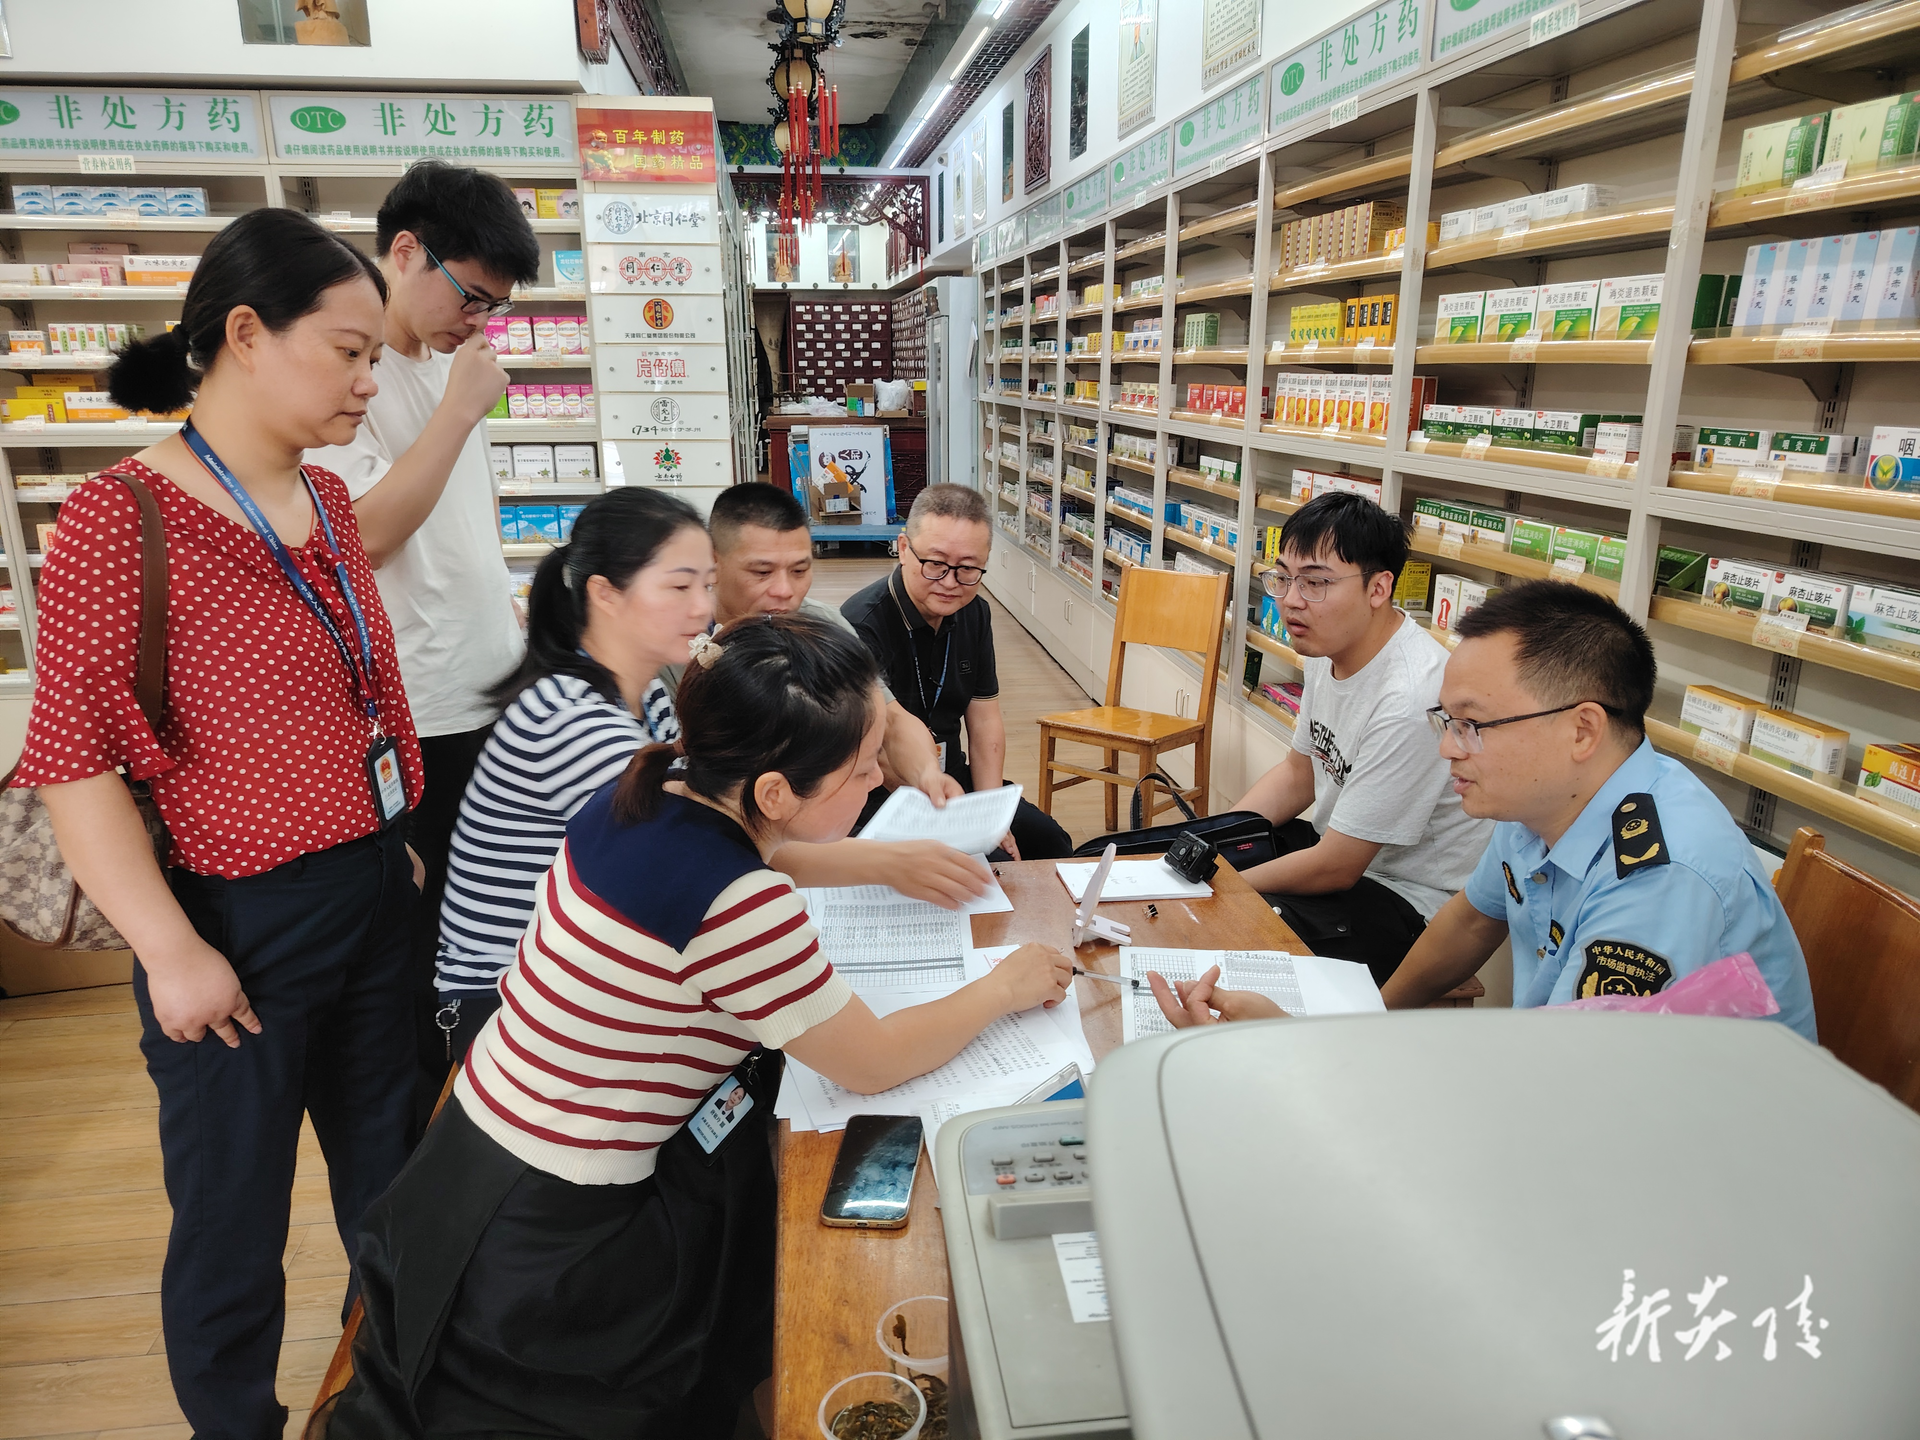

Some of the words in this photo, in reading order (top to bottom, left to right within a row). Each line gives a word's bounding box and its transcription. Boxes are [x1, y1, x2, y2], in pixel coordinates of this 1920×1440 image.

[1316, 0, 1418, 82] 非处方药
[1283, 65, 1303, 92] OTC
[47, 95, 241, 133] 非处方药
[295, 109, 342, 129] OTC
[1202, 79, 1260, 139] 非处方药
[372, 102, 555, 138] 非处方药
[612, 129, 685, 146] 百年制药
[284, 144, 567, 158] 请仔细阅读药品使用说明书并按说明使用或在执业药师的指导下购买和使用。
[82, 157, 134, 172] 营养补益用药
[634, 155, 703, 170] 国药精品
[636, 209, 700, 228] 北京同仁堂
[626, 261, 685, 274] 同仁堂
[1609, 285, 1658, 299] 消炎退热颗粒
[1754, 278, 1767, 308] 导赤丸
[1785, 275, 1798, 306] 导赤丸
[1816, 273, 1830, 305] 导赤丸
[1851, 270, 1865, 303] 导赤丸
[1889, 266, 1904, 300] 导赤丸
[637, 359, 686, 377] 片仔癀
[660, 400, 670, 422] 雷允上
[632, 425, 659, 435] 1734
[1543, 420, 1569, 430] 大卫颗粒
[1709, 434, 1747, 447] 咽炎片
[1782, 439, 1817, 452] 咽炎片
[1898, 438, 1920, 457] 咽
[203, 454, 234, 488] Administrative
[233, 489, 244, 501] Law
[243, 501, 269, 534] Enforcement
[267, 534, 279, 551] China
[1600, 545, 1625, 558] 蒲地蓝消
[1722, 571, 1760, 590] 麻杏止咳片
[1788, 586, 1833, 605] 麻杏止咳片
[1874, 602, 1920, 622] 麻杏止咳
[1757, 720, 1800, 741] 齿痛消炎灵颗粒
[1592, 945, 1666, 975] 中华人民共和国
[1596, 955, 1656, 982] 市场监管执法
